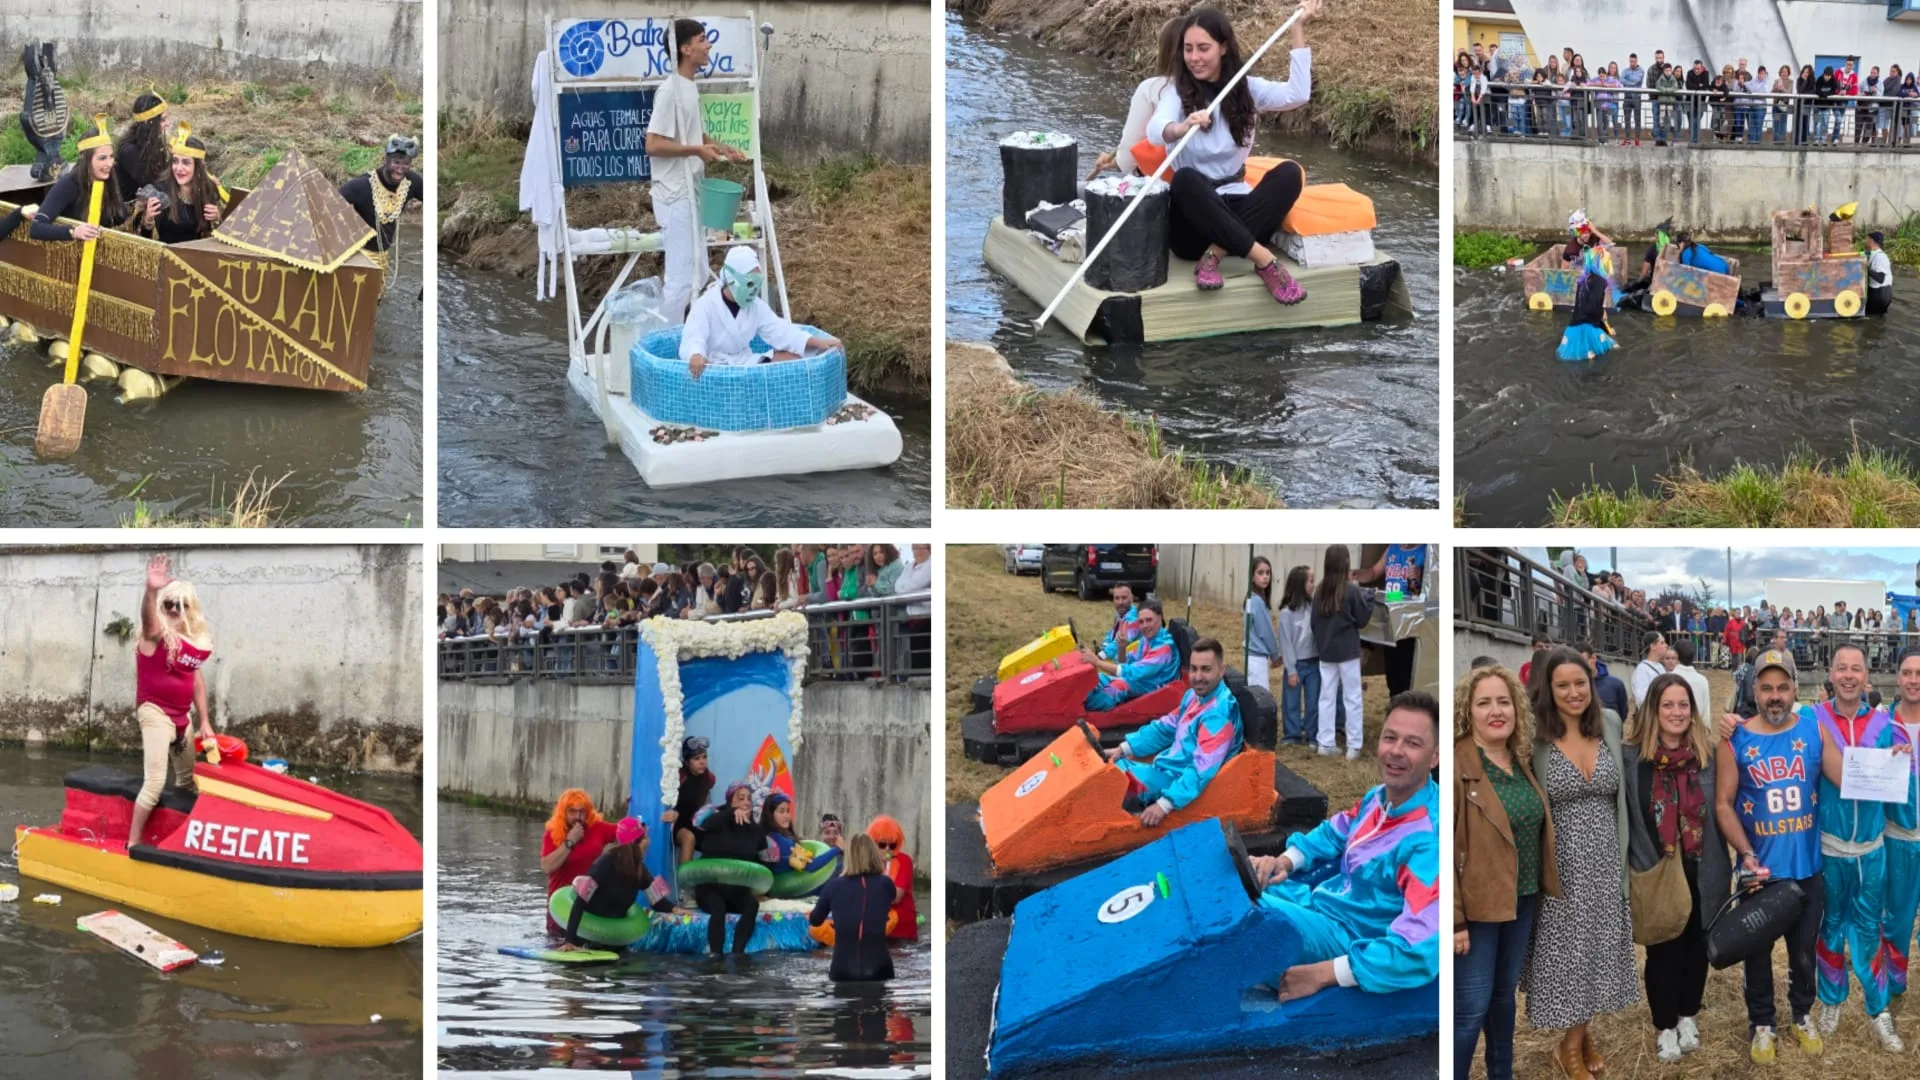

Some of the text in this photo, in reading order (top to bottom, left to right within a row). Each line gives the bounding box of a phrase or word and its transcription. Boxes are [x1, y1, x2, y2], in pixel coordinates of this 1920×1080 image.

[571, 108, 653, 129] AGUAS TERMALES
[704, 101, 742, 119] vaya
[730, 116, 749, 135] las
[582, 128, 612, 153] PARA
[566, 155, 652, 177] TODOS LOS MALE
[217, 259, 367, 357] TUTAN
[162, 276, 332, 387] FLOTAMON
[1747, 755, 1806, 789] NBA
[1766, 785, 1802, 814] 69
[184, 820, 310, 864] RESCATE
[1106, 891, 1144, 915] 5
